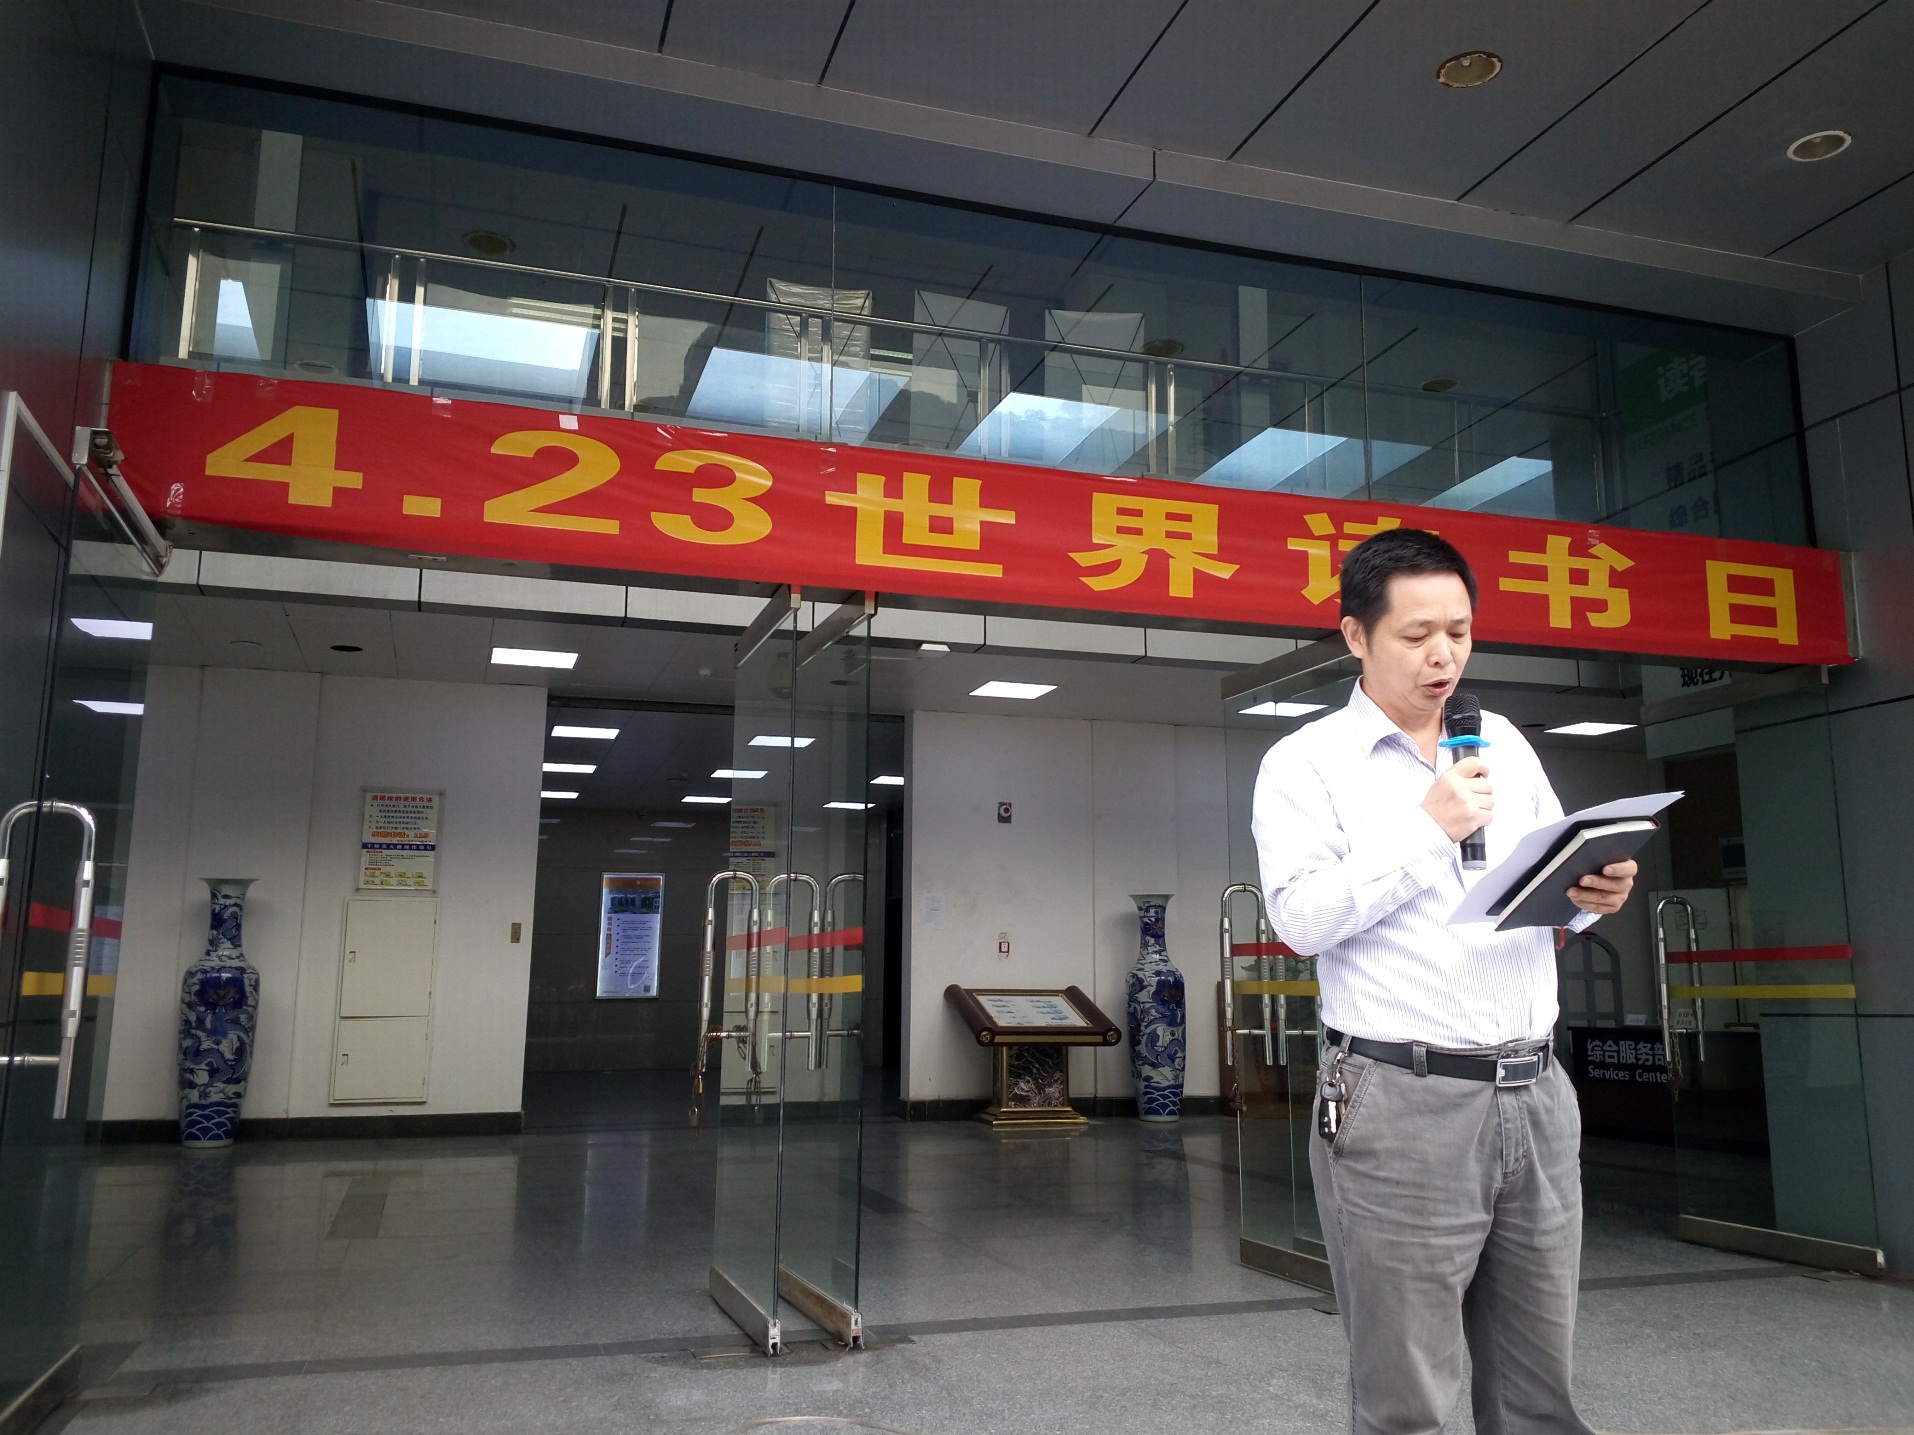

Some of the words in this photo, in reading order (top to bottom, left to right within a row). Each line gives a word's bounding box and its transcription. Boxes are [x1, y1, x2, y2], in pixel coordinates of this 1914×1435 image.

[1666, 452, 1713, 488] 精品
[1669, 491, 1719, 528] 综合
[1588, 1065, 1630, 1081] Services
